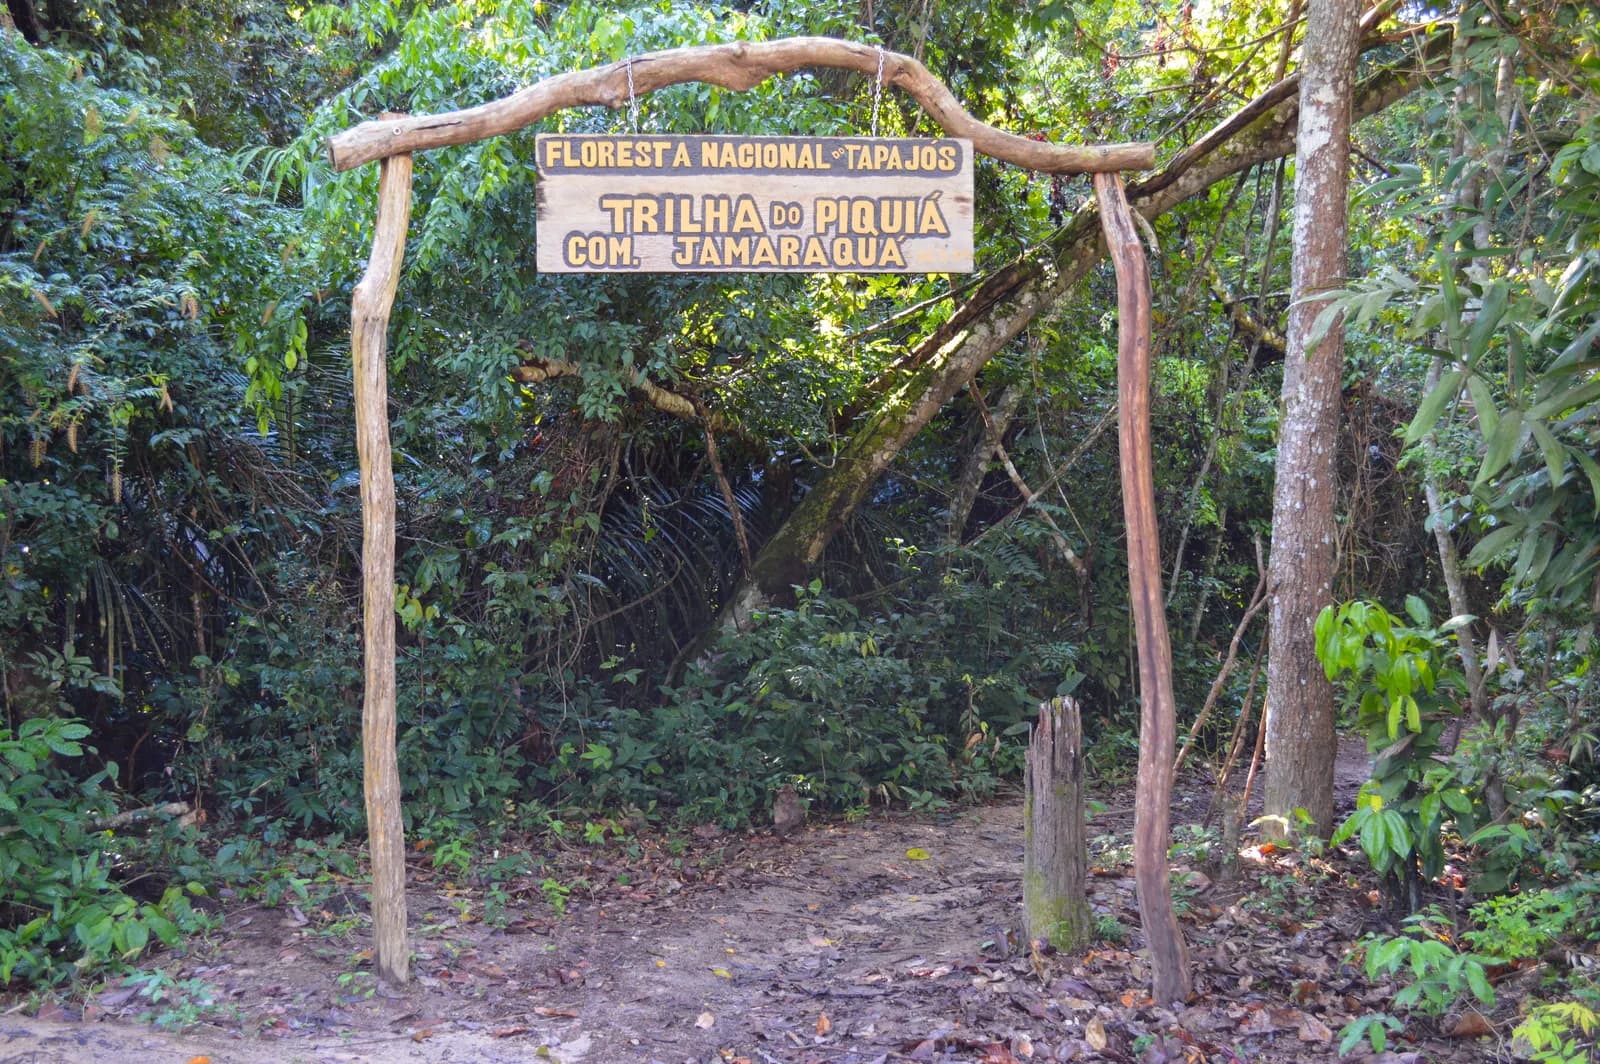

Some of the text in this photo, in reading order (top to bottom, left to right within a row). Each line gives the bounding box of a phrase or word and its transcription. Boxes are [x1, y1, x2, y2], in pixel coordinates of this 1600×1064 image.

[545, 139, 957, 171] FLORESTA NACIONAL DO TAPAJÓS
[602, 192, 948, 236] TRILHA DO PIQUIÁ
[568, 236, 639, 266] COM.
[675, 236, 905, 267] JAMARAQUÁ
